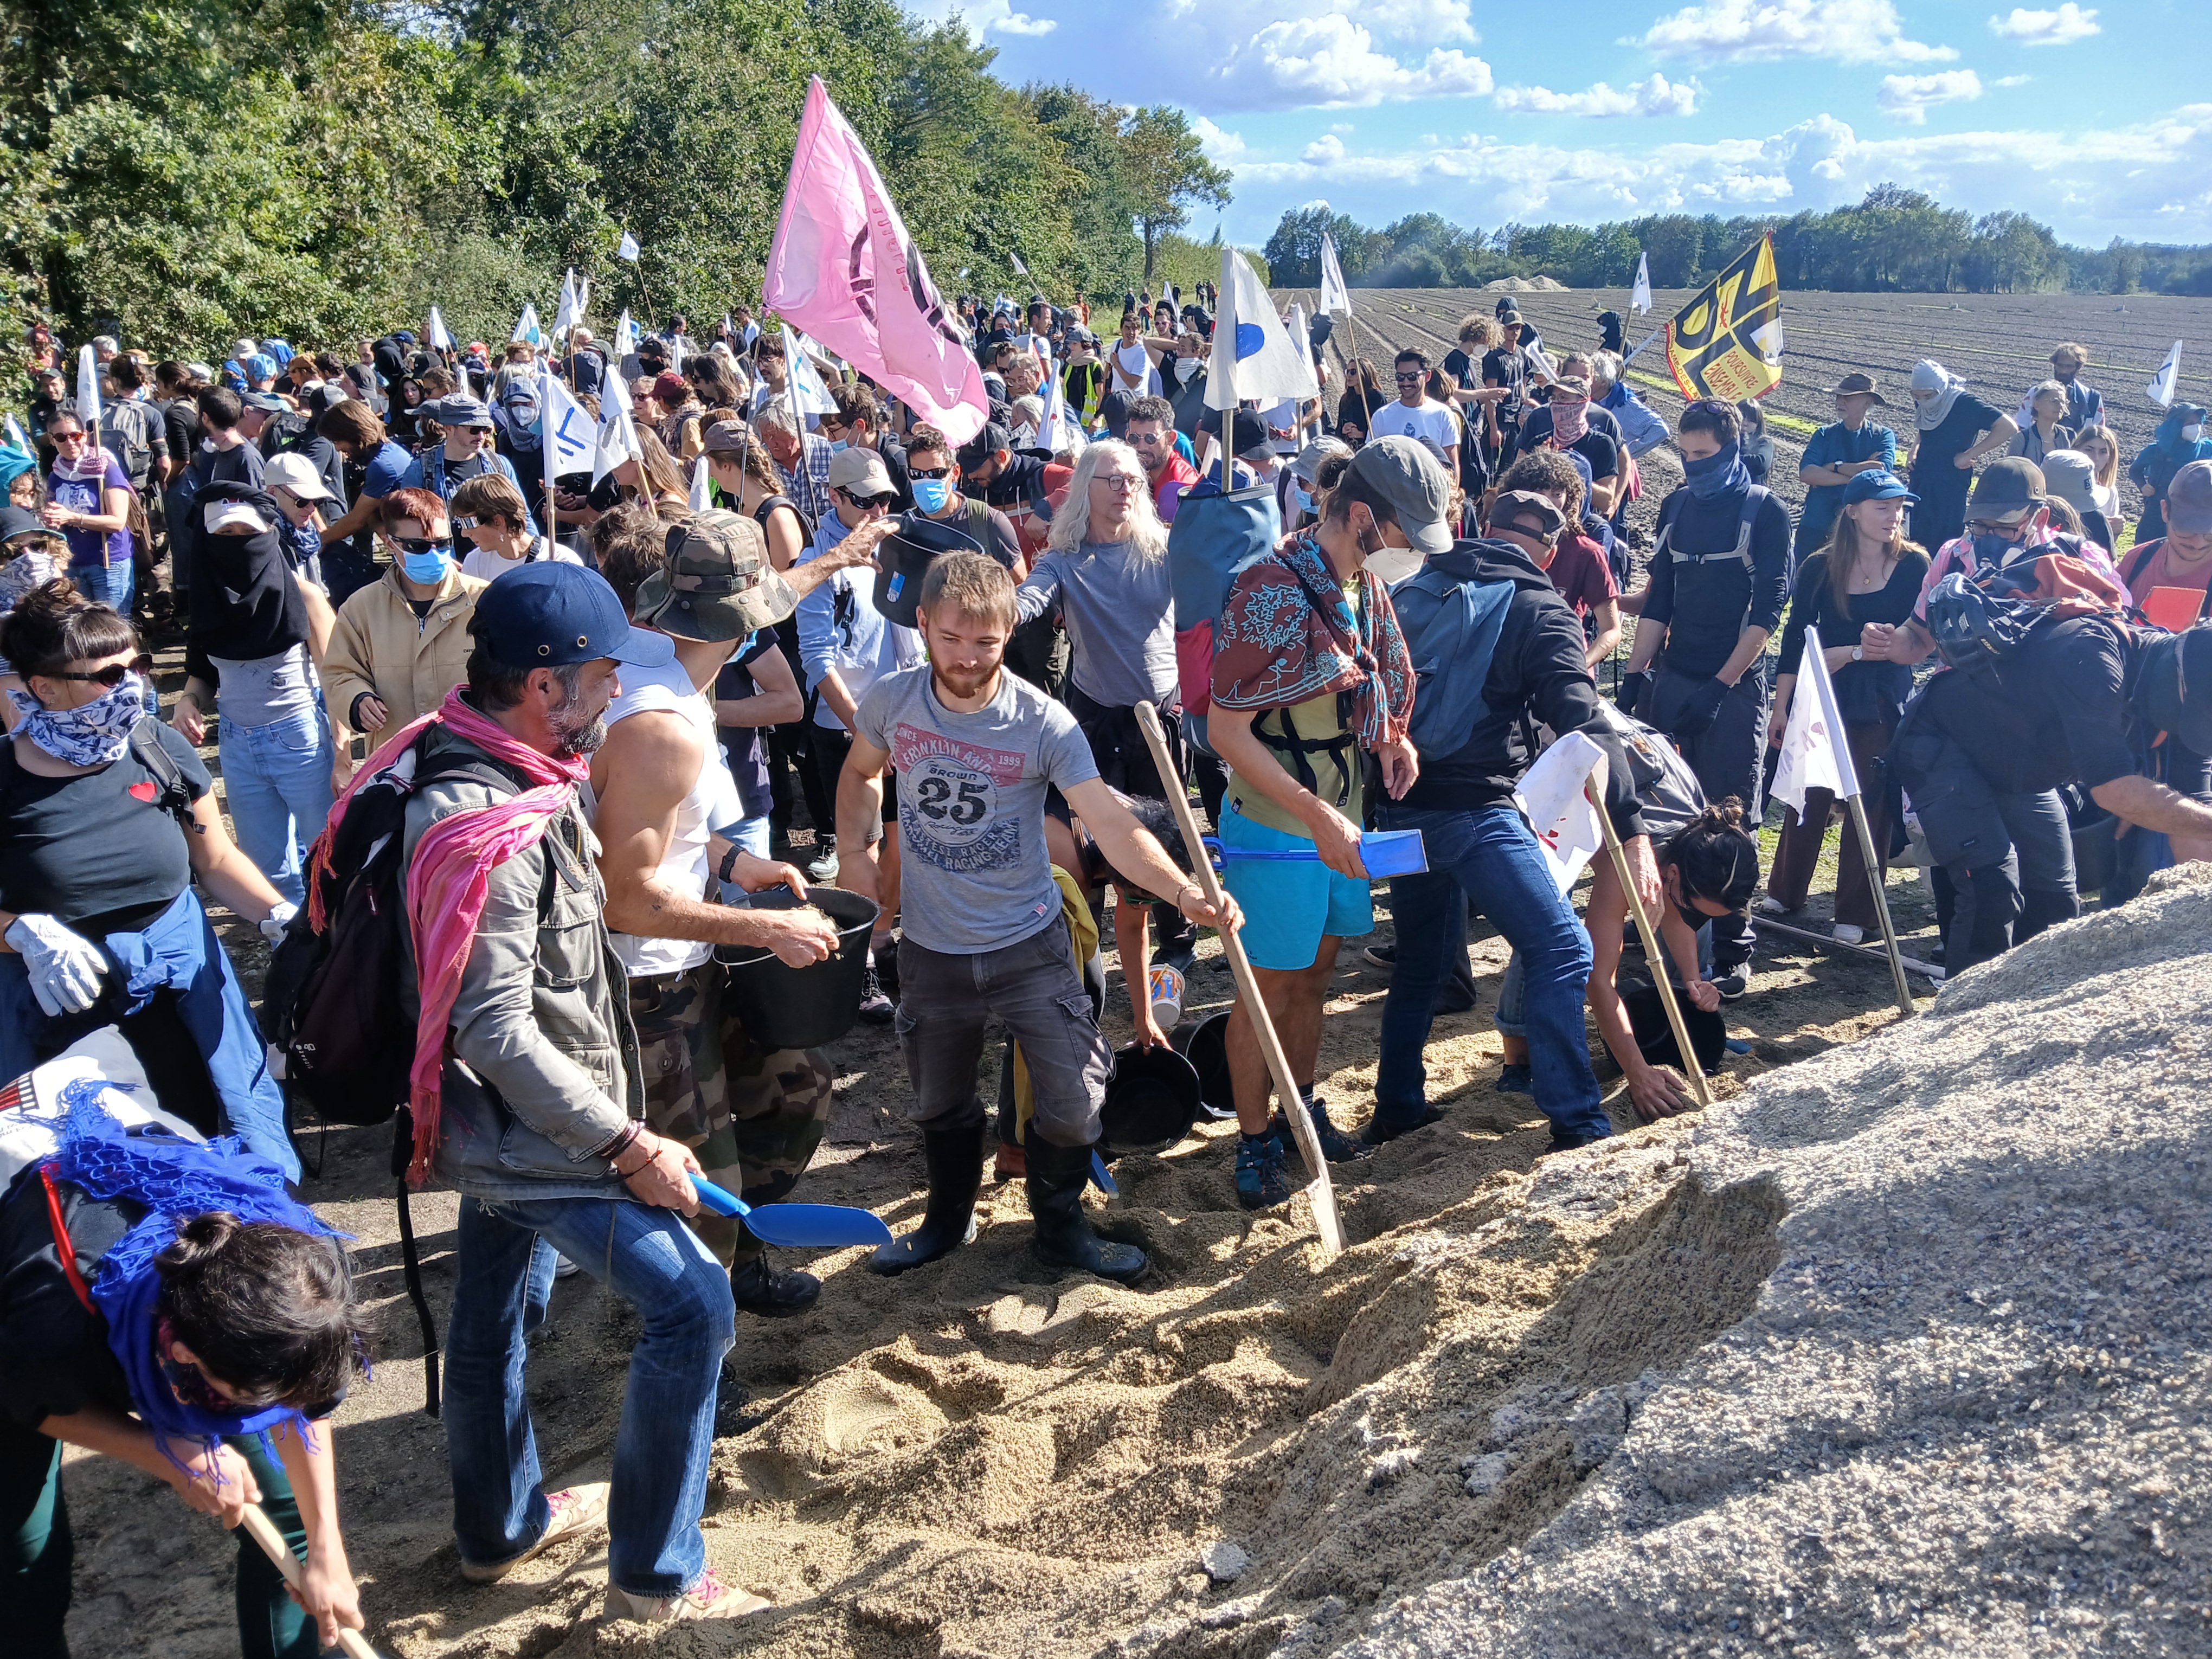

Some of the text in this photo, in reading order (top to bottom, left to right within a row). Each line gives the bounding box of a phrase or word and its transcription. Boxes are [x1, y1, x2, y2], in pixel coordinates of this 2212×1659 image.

[1704, 362, 1742, 400] ENSEMBLE
[1724, 350, 1759, 389] POURSUIVRE
[962, 750, 993, 774] AND
[998, 755, 1021, 767] 1999
[917, 777, 989, 825] 25
[945, 851, 992, 871] RACING
[989, 823, 1018, 855] TEAM
[304, 1043, 316, 1051] 40
